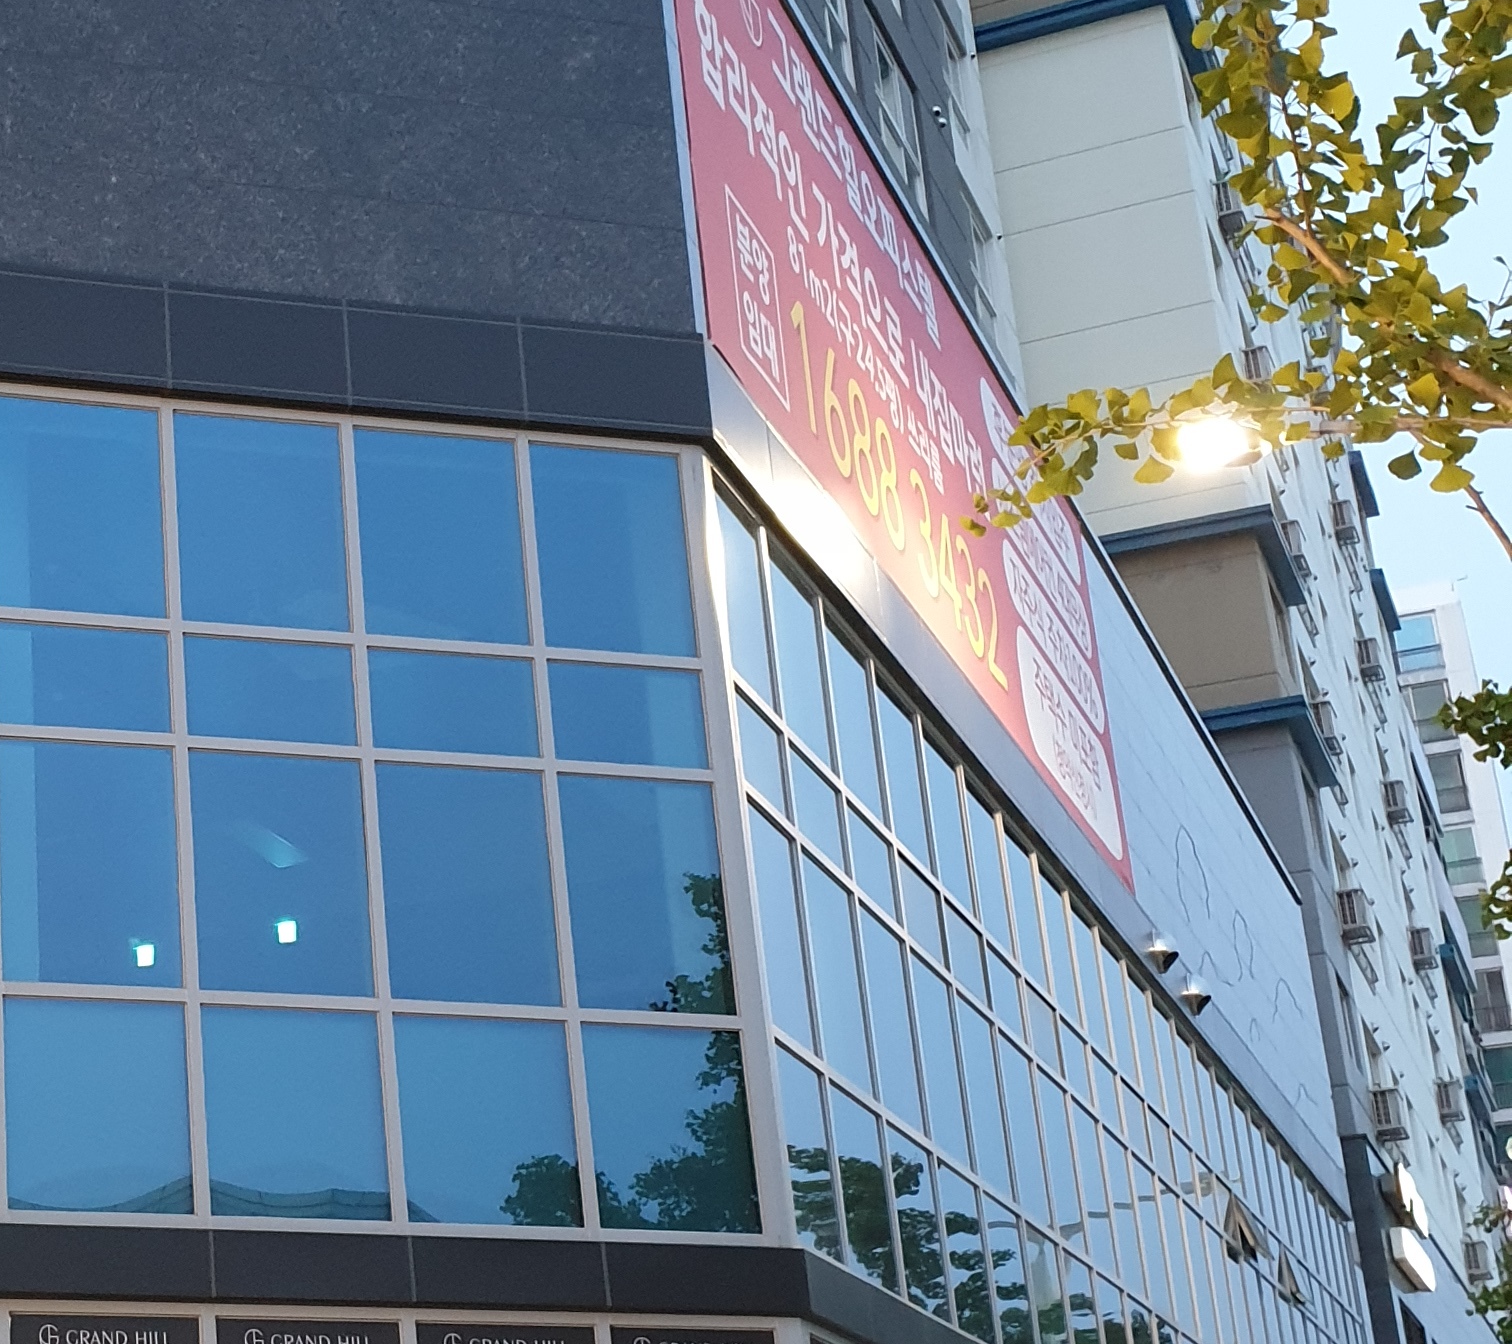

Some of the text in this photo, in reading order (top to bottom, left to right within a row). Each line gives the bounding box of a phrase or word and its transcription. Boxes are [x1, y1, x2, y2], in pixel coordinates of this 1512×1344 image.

[736, 214, 770, 305] 분양
[768, 7, 942, 351] 그랜드힐오피스텔
[742, 291, 780, 383] 임대
[811, 181, 910, 391] 가격으로
[910, 337, 991, 522] 내집마련
[790, 300, 1008, 692] 1688 3432
[906, 403, 945, 496] 쓰리룸
